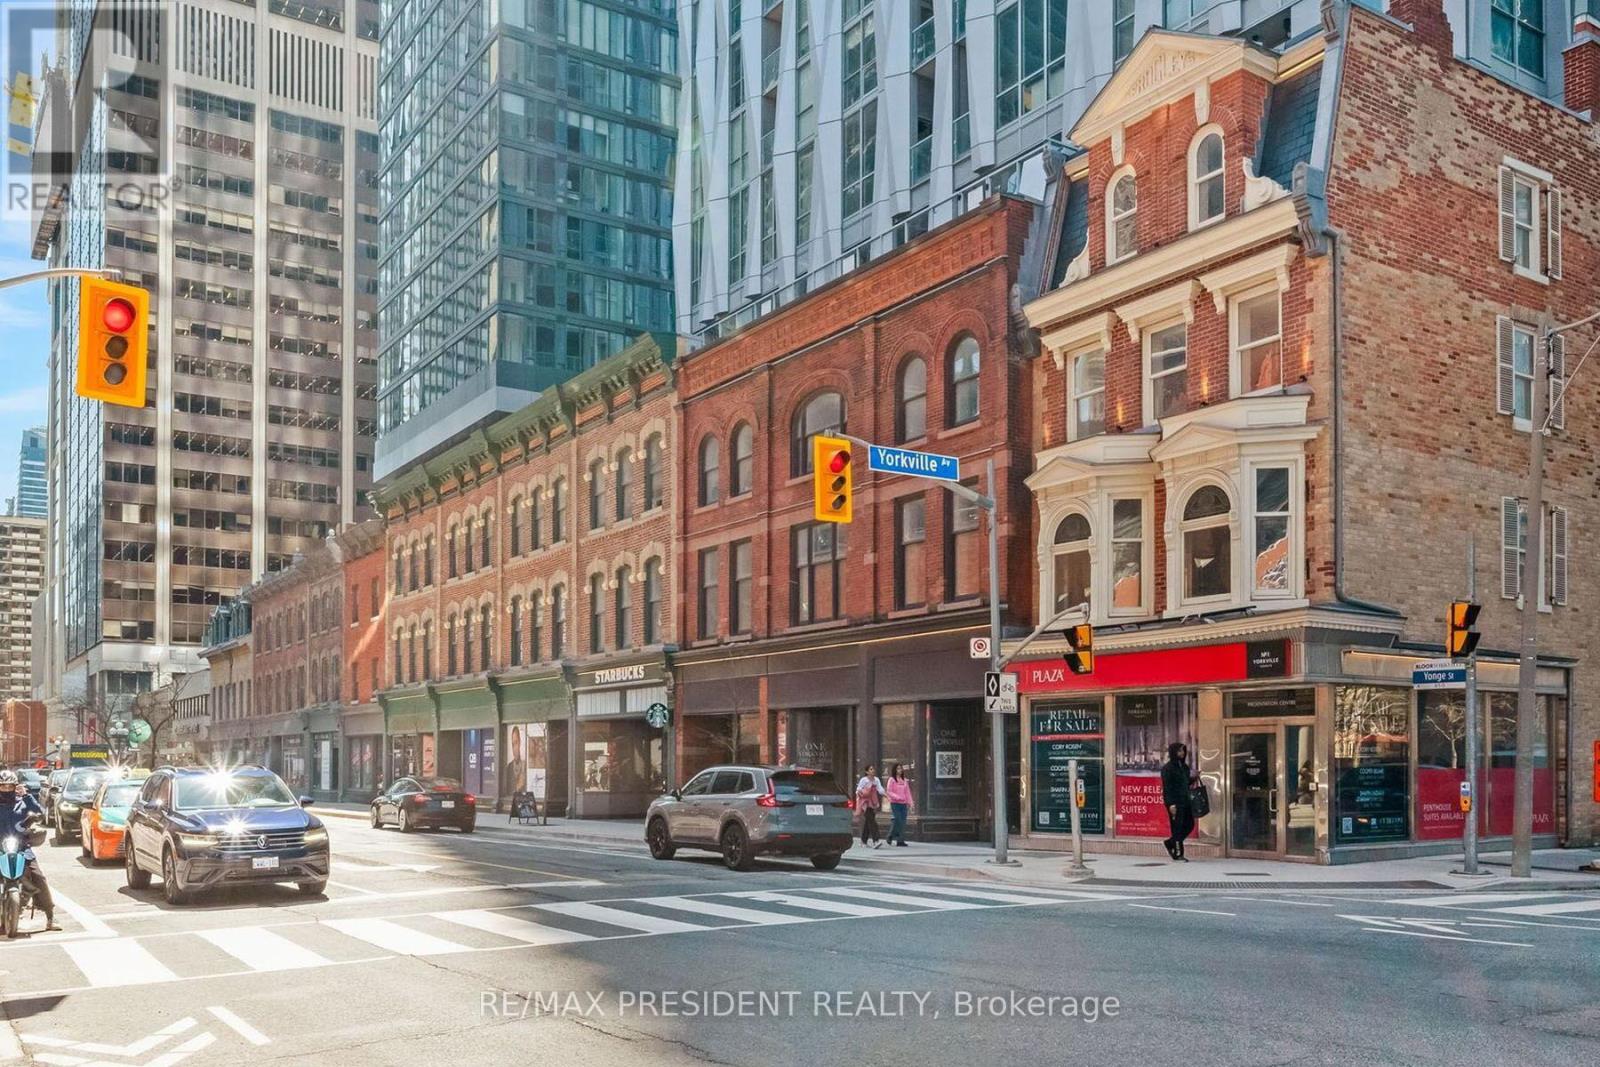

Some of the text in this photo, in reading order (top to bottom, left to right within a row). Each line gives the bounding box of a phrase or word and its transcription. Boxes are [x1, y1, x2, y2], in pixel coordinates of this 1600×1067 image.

[878, 449, 951, 471] Yorkville Av
[595, 665, 645, 684] STARBUCKS
[1032, 668, 1065, 684] PLAZA
[1424, 672, 1447, 681] Yonge
[1050, 709, 1089, 721] RETAIL
[1065, 719, 1097, 731] SALE
[1120, 785, 1140, 794] NEW
[1120, 795, 1165, 804] PENTHOUS
[1121, 805, 1148, 814] SUITES
[1423, 803, 1452, 811] PENTHOUSE
[1423, 813, 1440, 821] SUITES
